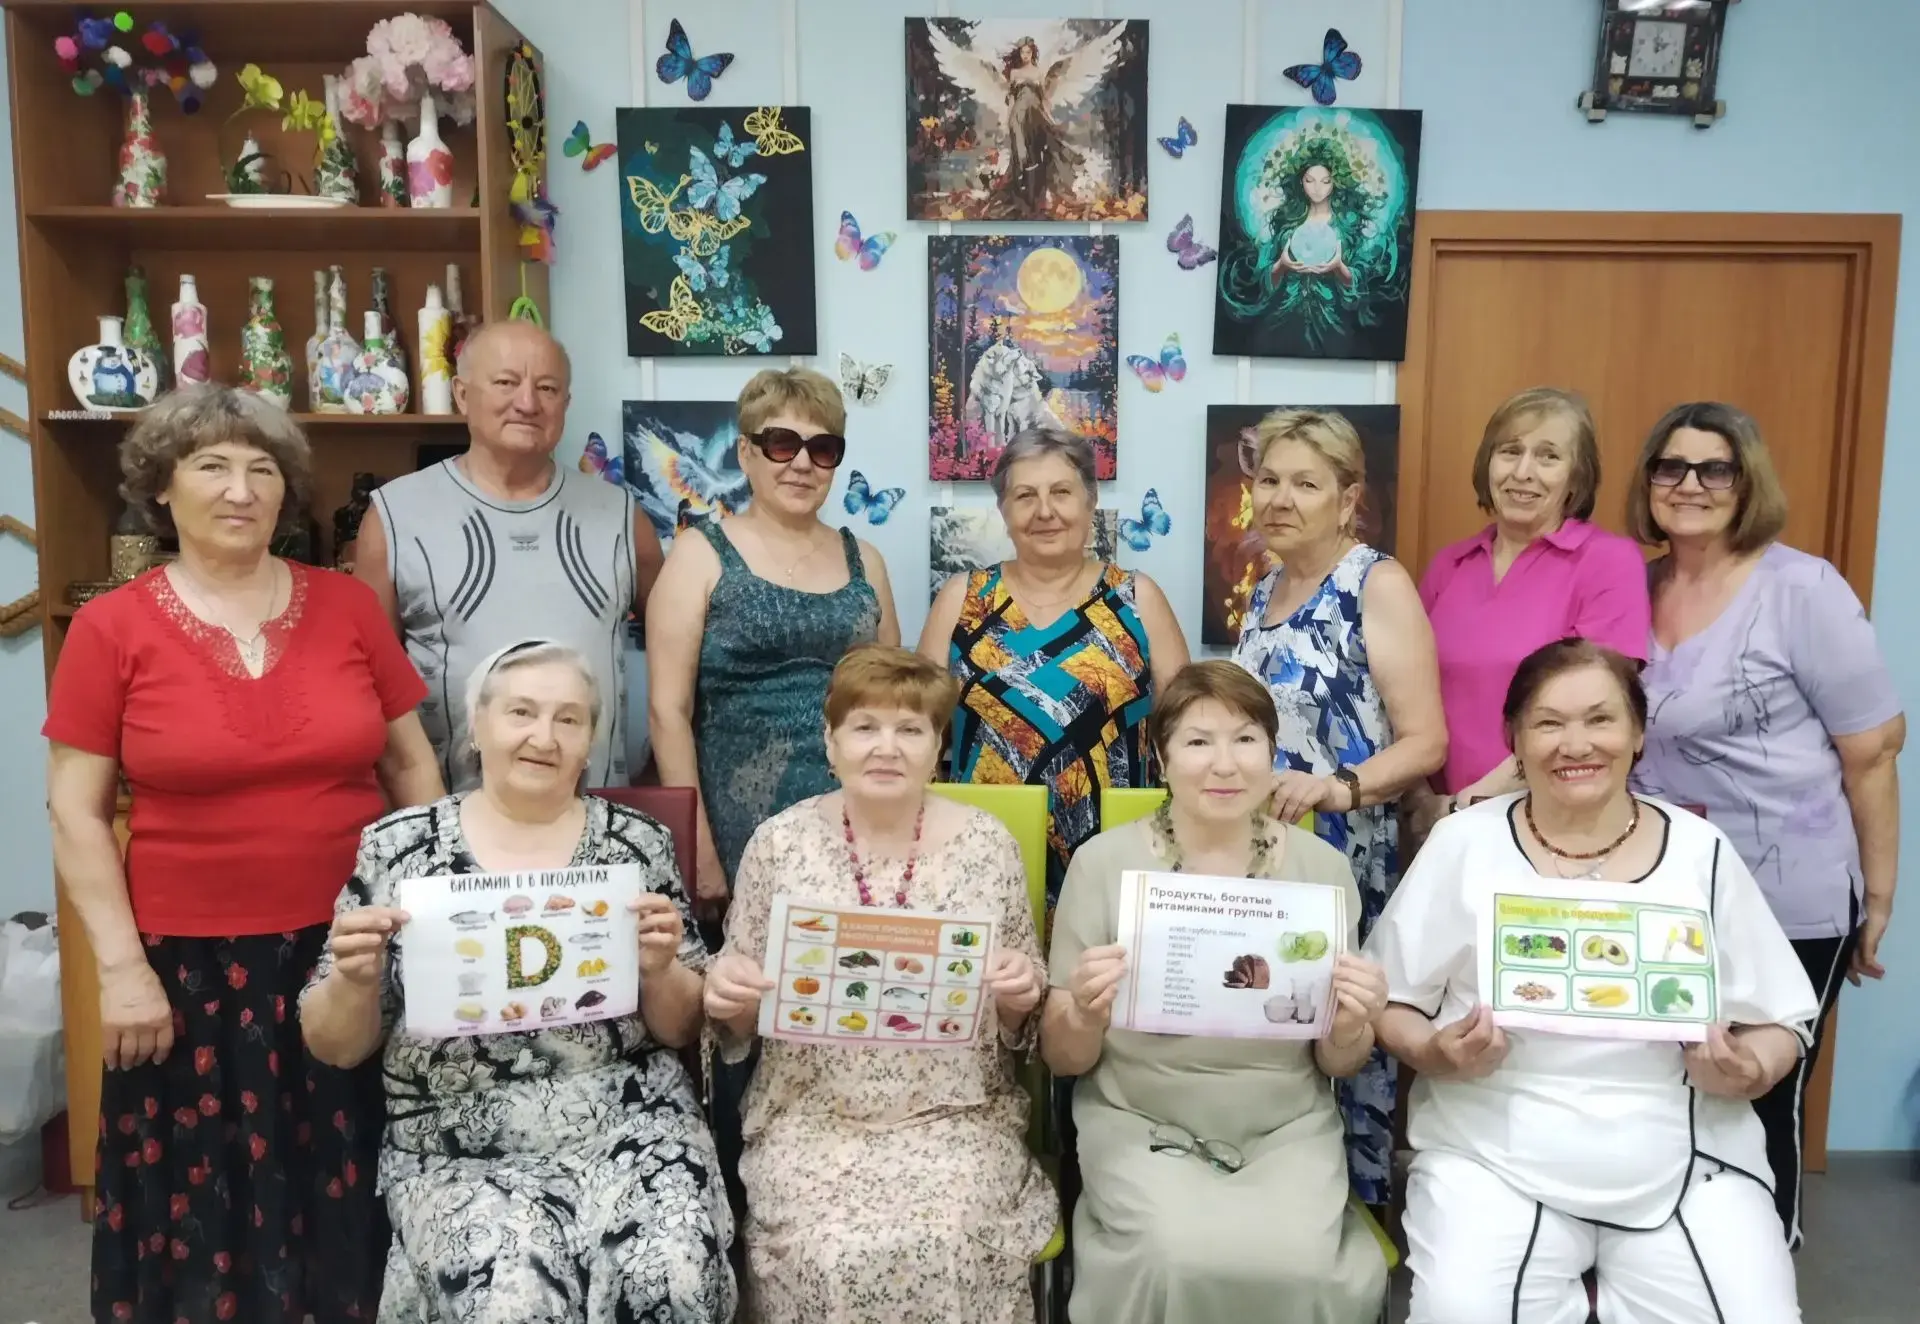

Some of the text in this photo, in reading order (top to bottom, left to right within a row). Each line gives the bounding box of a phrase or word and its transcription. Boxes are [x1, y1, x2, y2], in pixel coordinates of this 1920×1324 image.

[450, 874, 511, 893] ВИТАМИН
[541, 869, 609, 887] ПРОДУКТАХ
[1150, 887, 1272, 905] Продукты, богатые
[1149, 901, 1224, 914] витаминами
[1228, 907, 1272, 918] группы
